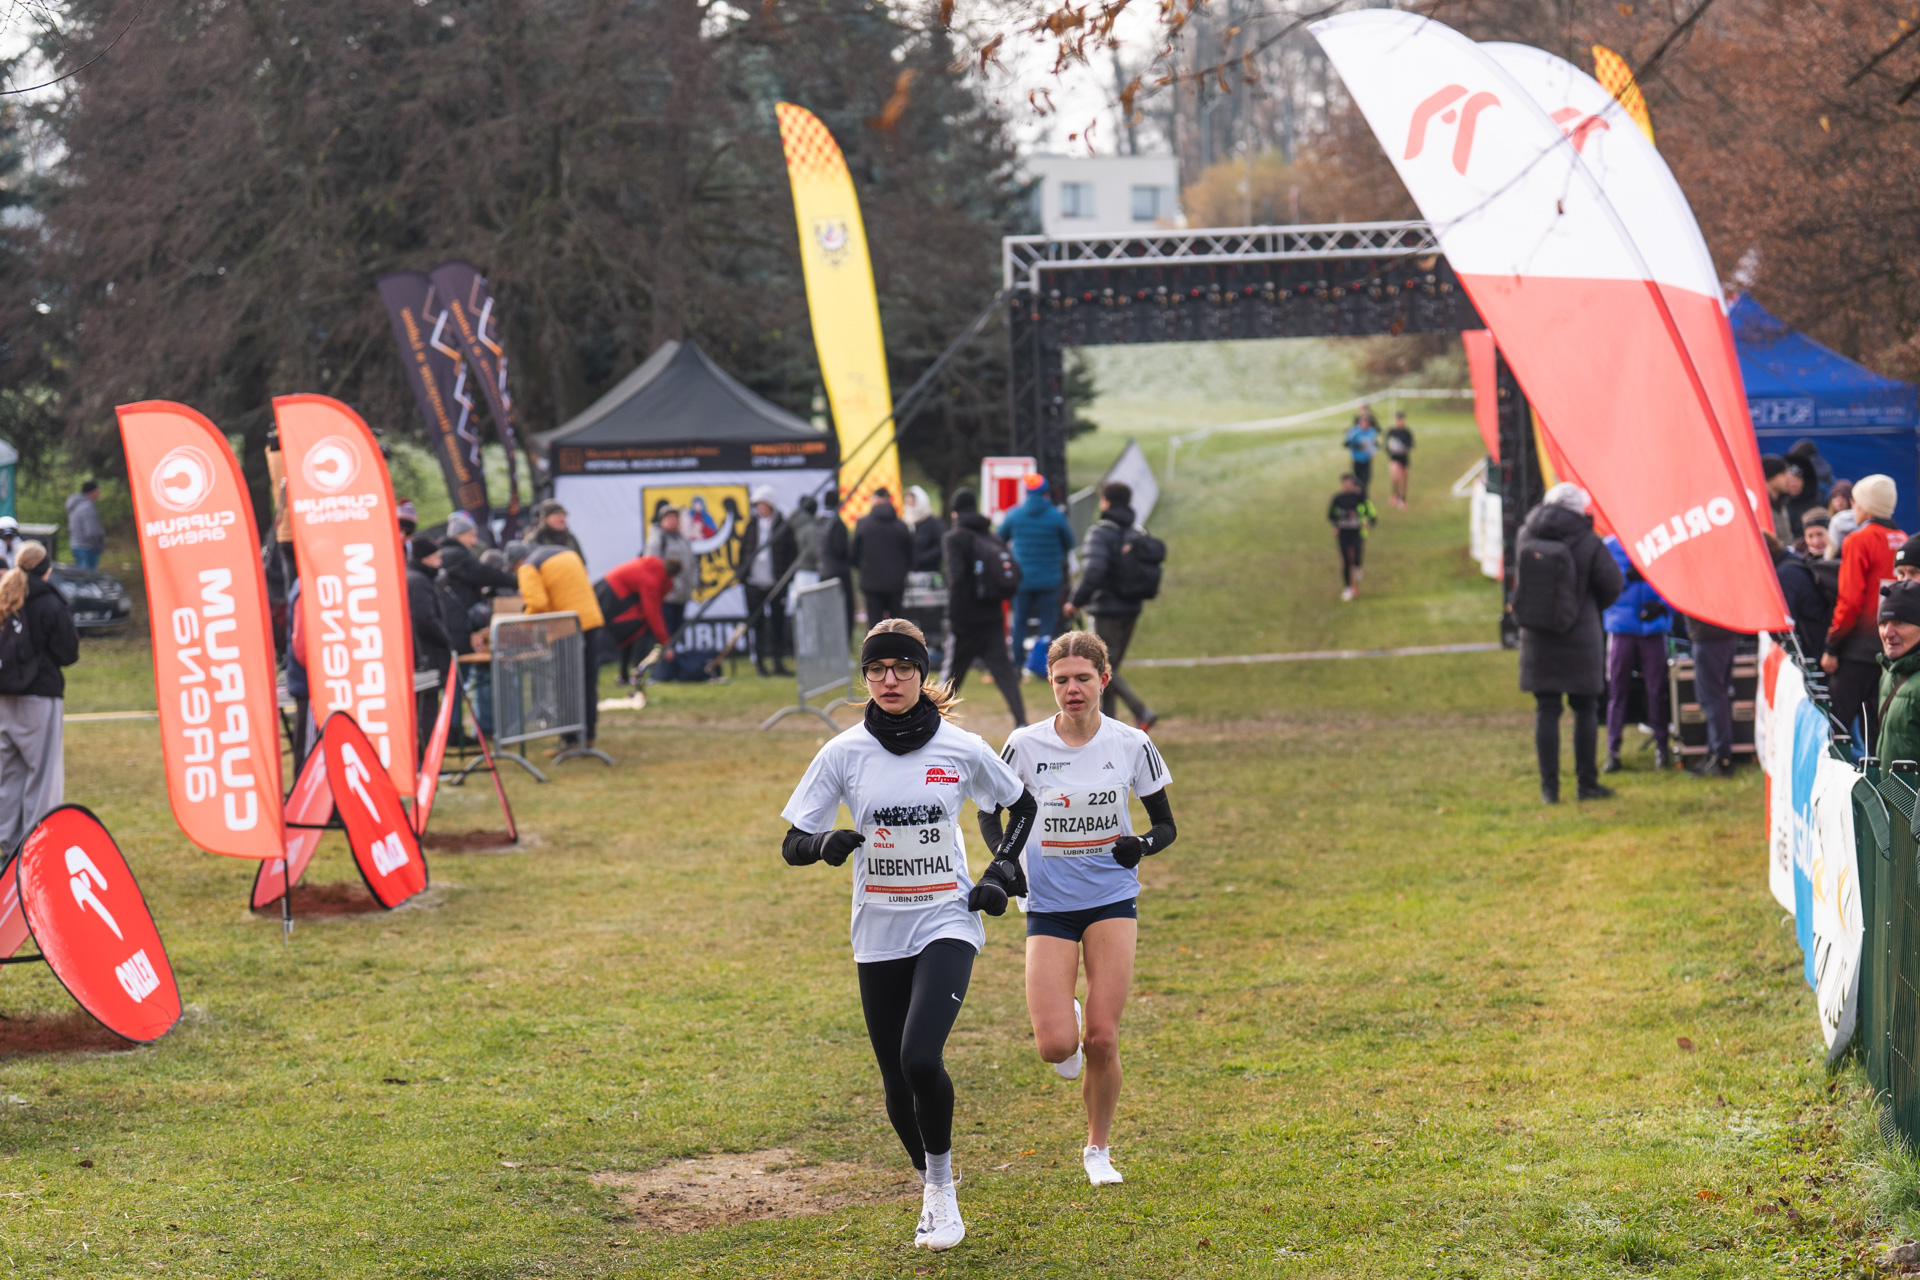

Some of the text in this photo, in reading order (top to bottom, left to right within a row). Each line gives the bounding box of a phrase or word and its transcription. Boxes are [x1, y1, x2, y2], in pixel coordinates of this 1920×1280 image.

[1088, 790, 1117, 806] 220
[1044, 813, 1119, 835] STRZĄBAŁA
[919, 828, 941, 845] 38
[1086, 847, 1103, 855] 2025
[868, 855, 954, 877] LIEBENTHAL
[913, 894, 934, 902] 2025
